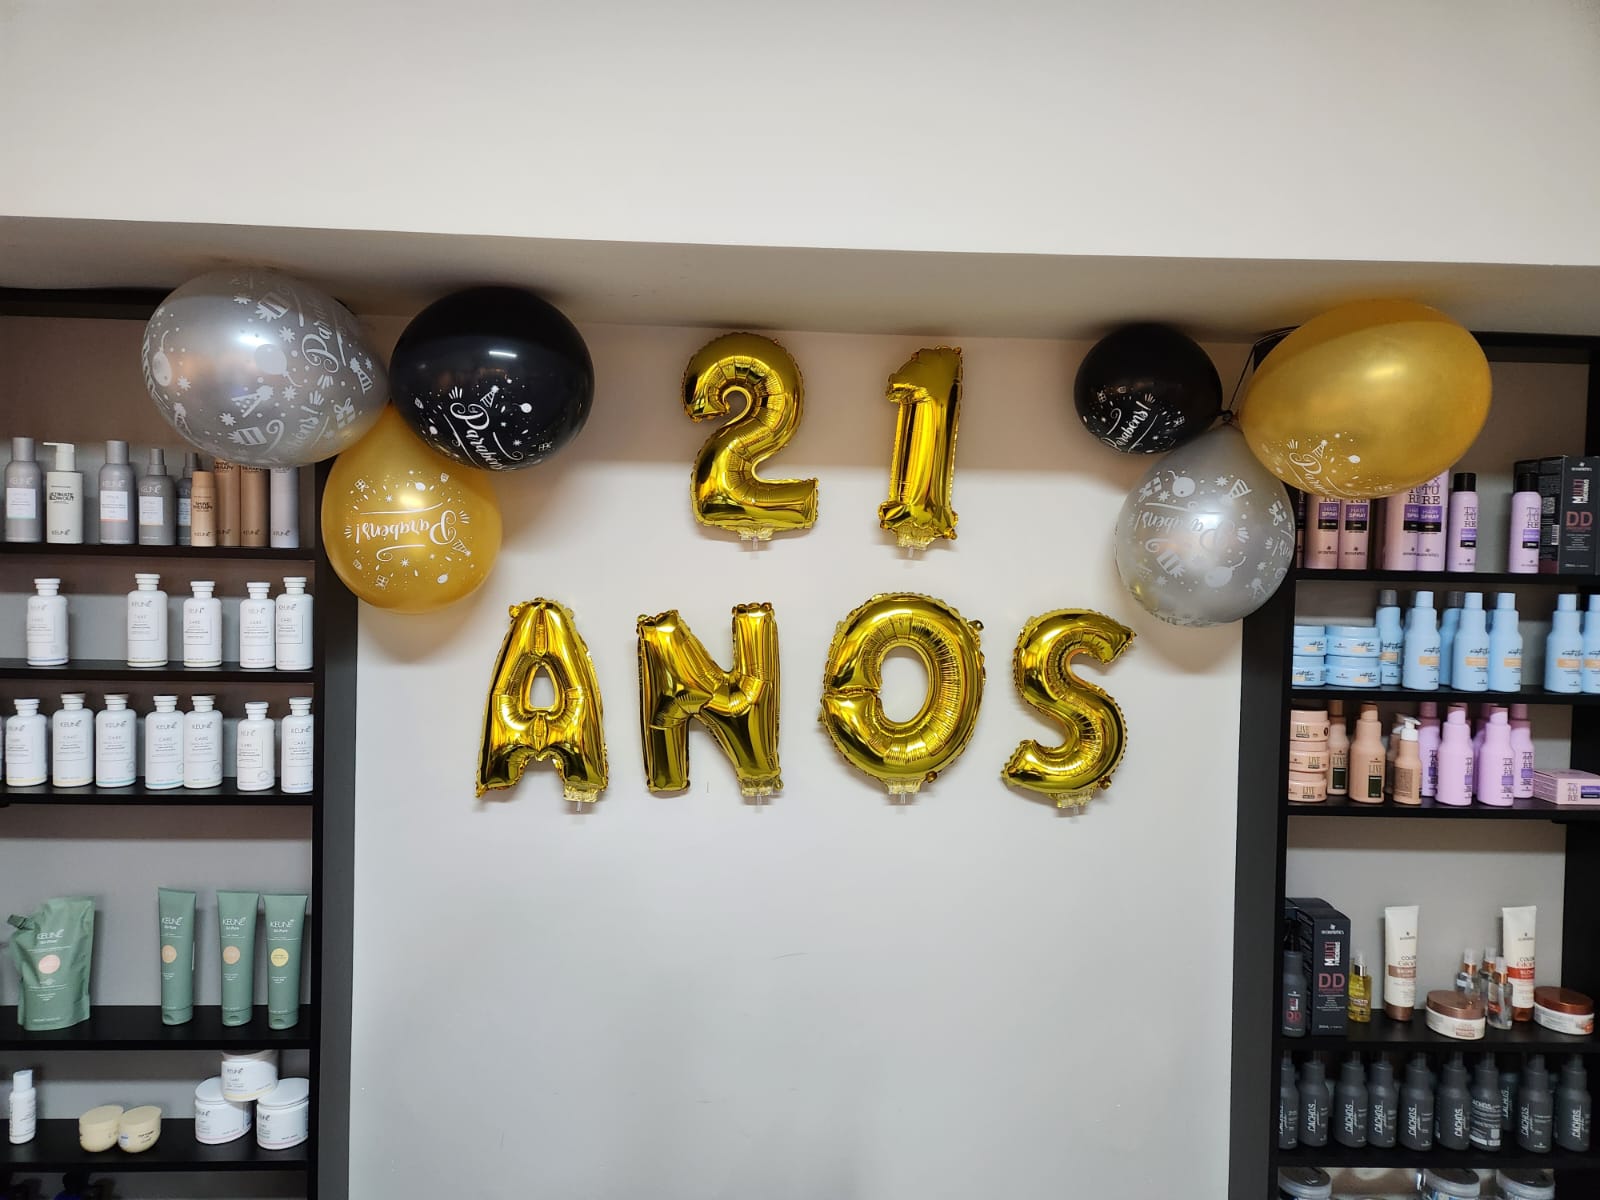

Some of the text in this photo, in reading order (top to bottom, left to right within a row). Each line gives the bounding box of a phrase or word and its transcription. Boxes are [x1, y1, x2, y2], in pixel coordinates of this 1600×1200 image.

[682, 331, 963, 540] 21
[1422, 496, 1440, 504] RE
[354, 510, 457, 546] Parabéns!
[1566, 511, 1593, 527] DD
[475, 594, 1136, 798] ANOS
[161, 917, 183, 926] KEUNE
[222, 917, 246, 926] KEUNE
[270, 919, 294, 928] KEUNE
[1318, 973, 1345, 988] DD
[1308, 1103, 1317, 1133] CACHOS
[1344, 1104, 1354, 1133] CACHOS
[1374, 1104, 1384, 1134] CACHOS
[1408, 1107, 1417, 1136] CACHOS
[1454, 1108, 1463, 1137] CACHOS
[1521, 1106, 1530, 1136] CACHOS
[1572, 1110, 1581, 1138] CACHOS
